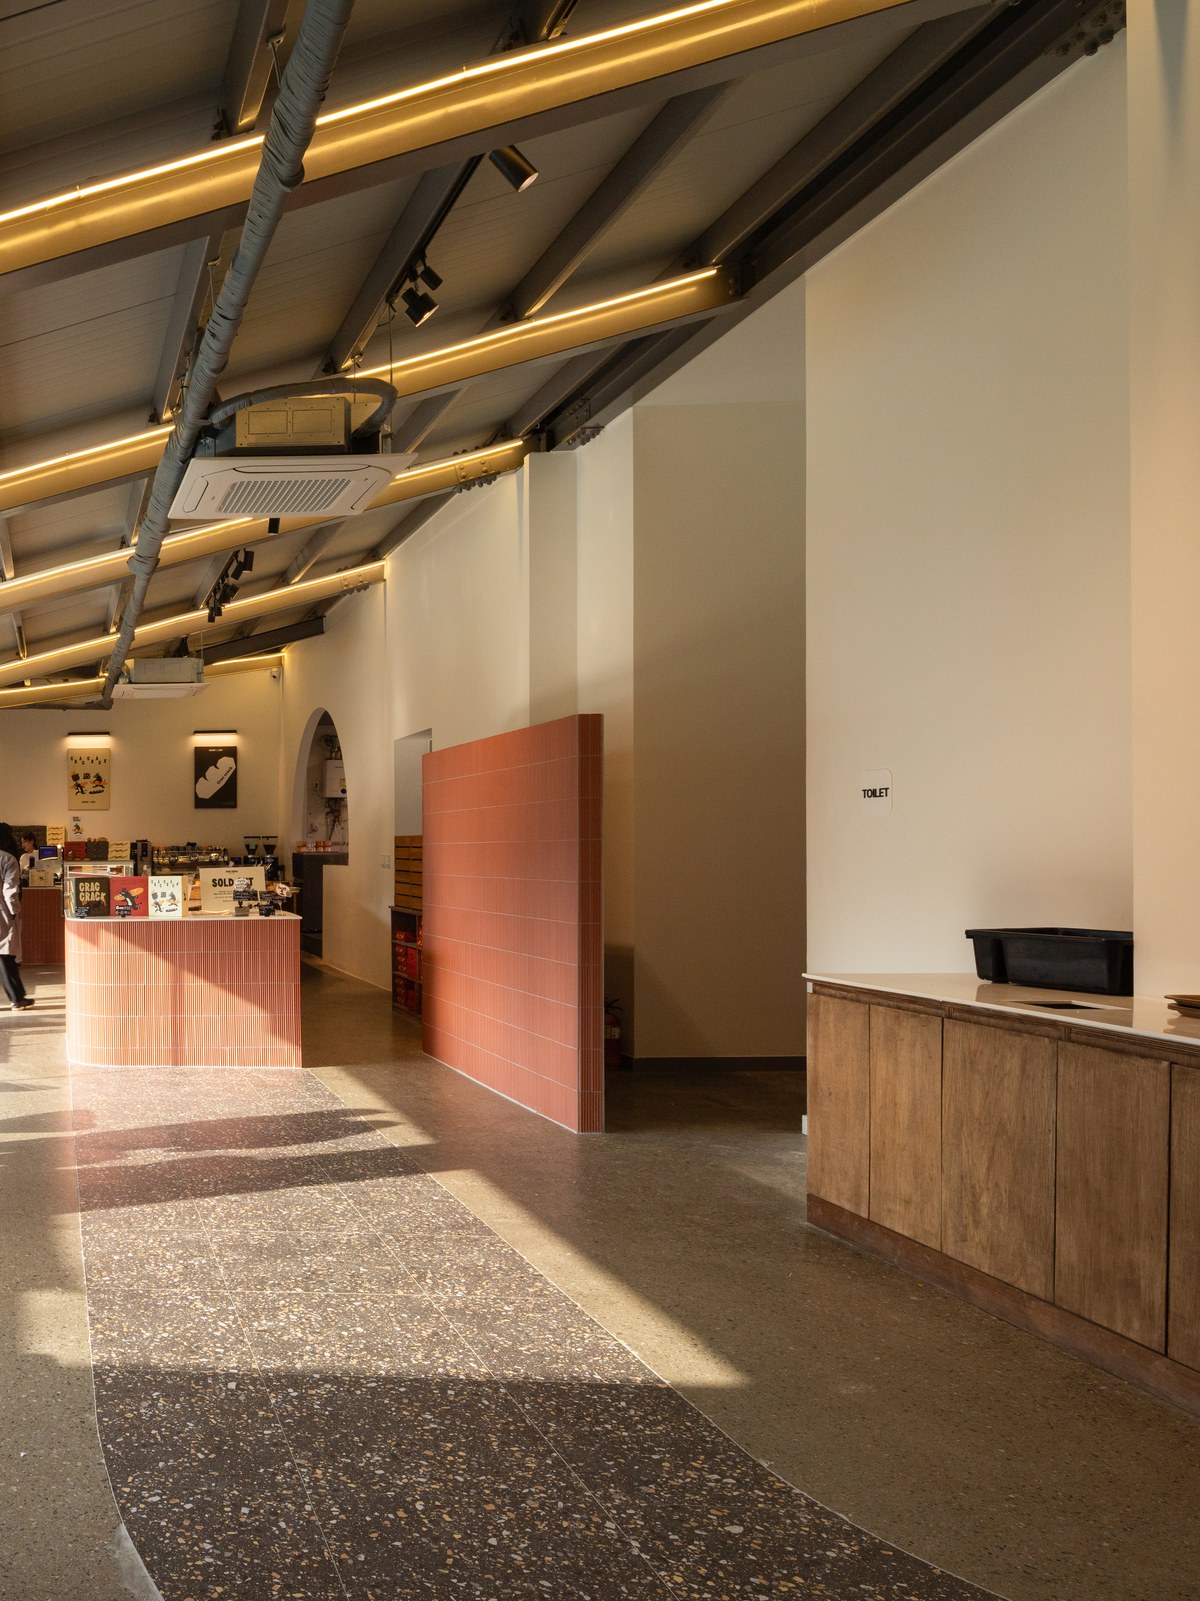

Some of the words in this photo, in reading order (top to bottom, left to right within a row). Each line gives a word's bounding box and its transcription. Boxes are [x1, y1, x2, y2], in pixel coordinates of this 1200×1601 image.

[861, 787, 890, 799] TOILET
[79, 882, 100, 892] CRAC
[212, 878, 234, 888] SOLD
[79, 892, 106, 903] CRACK
